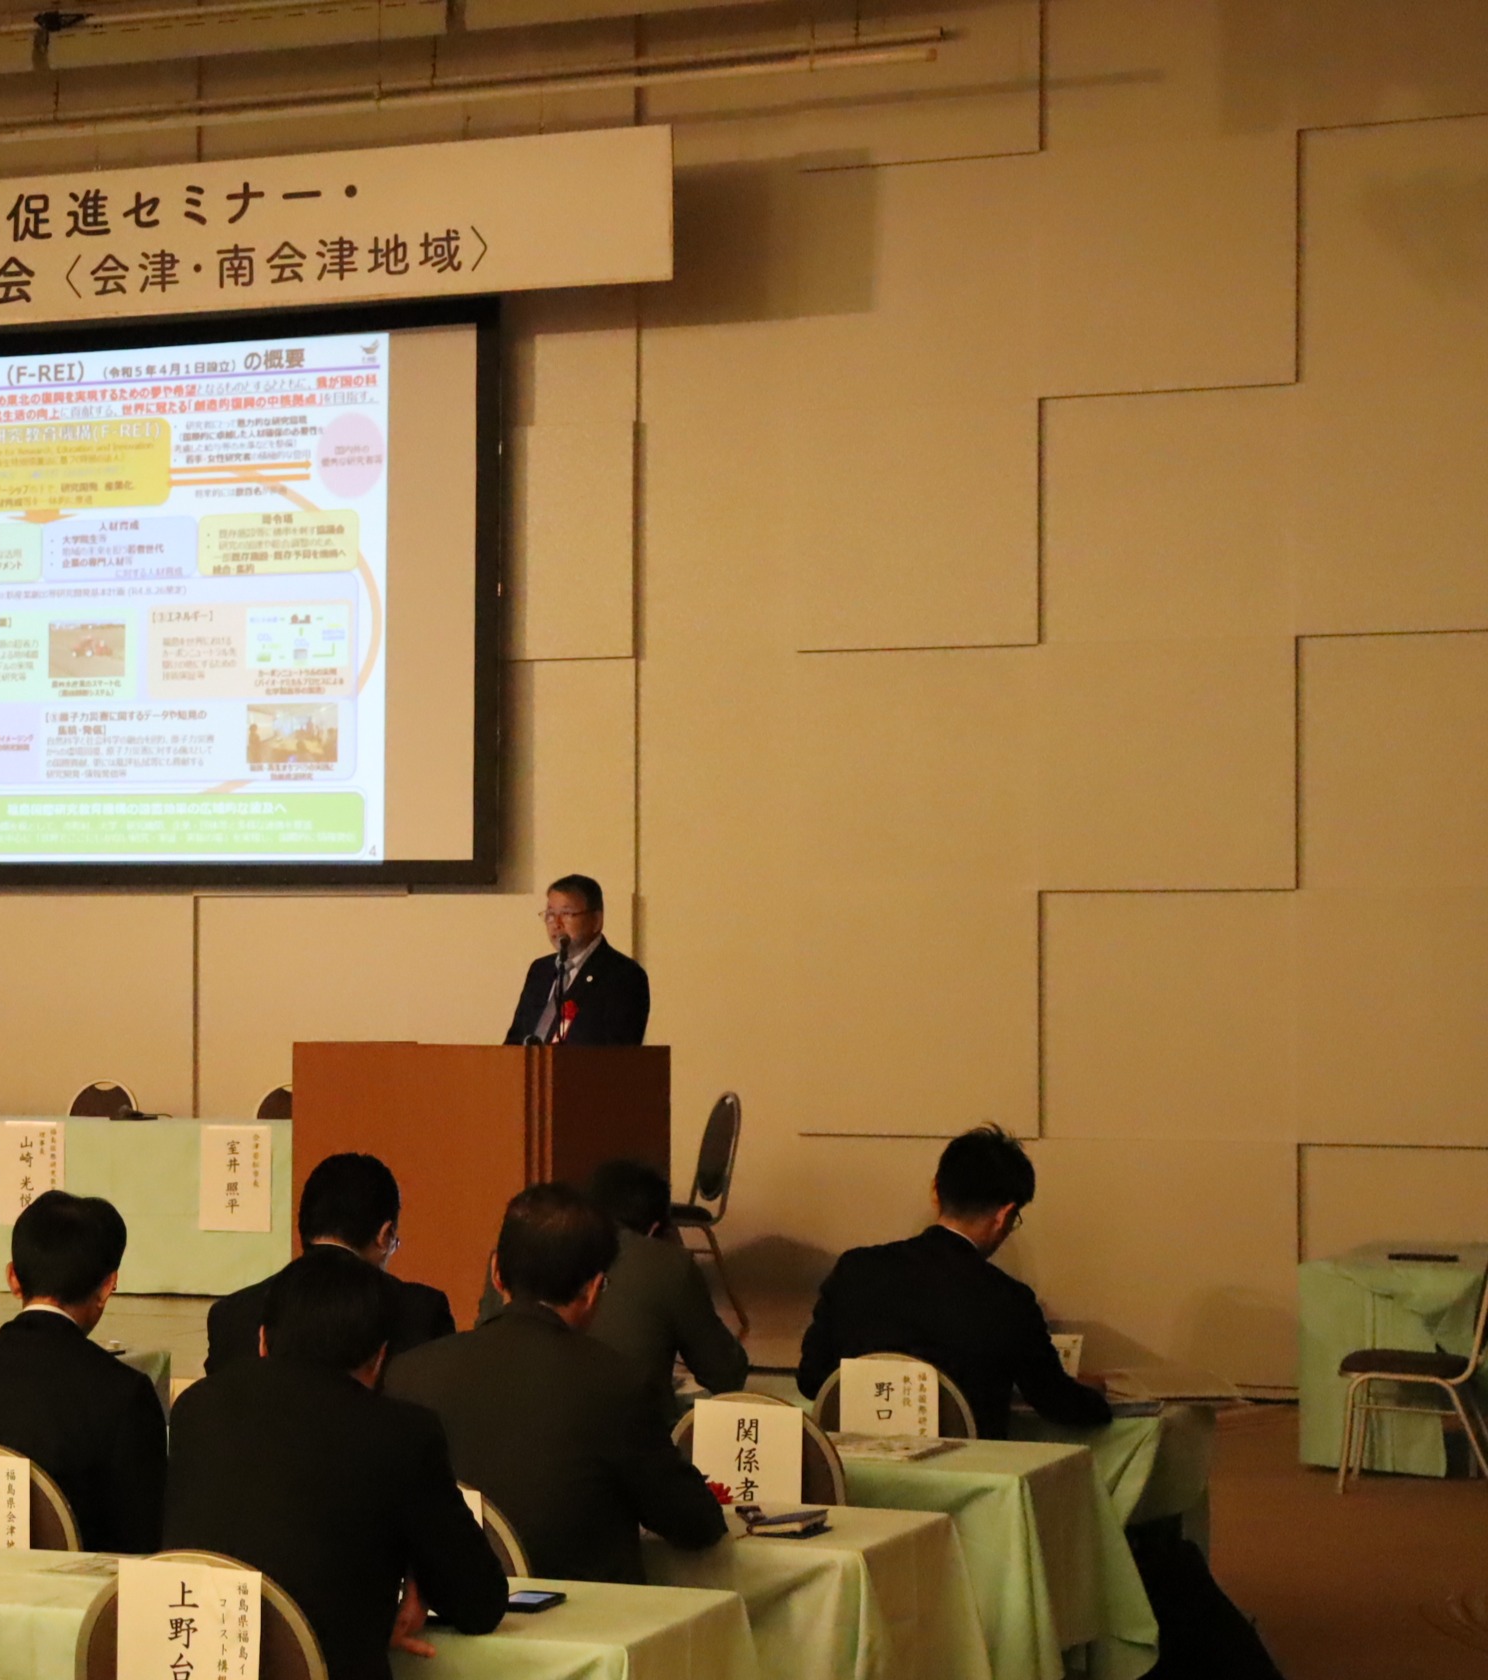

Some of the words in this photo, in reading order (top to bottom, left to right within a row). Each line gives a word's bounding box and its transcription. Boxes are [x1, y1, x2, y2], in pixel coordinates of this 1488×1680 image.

[874, 1382, 894, 1420] 野口
[735, 1418, 759, 1502] 関係者
[168, 1581, 199, 1680] 上野台
